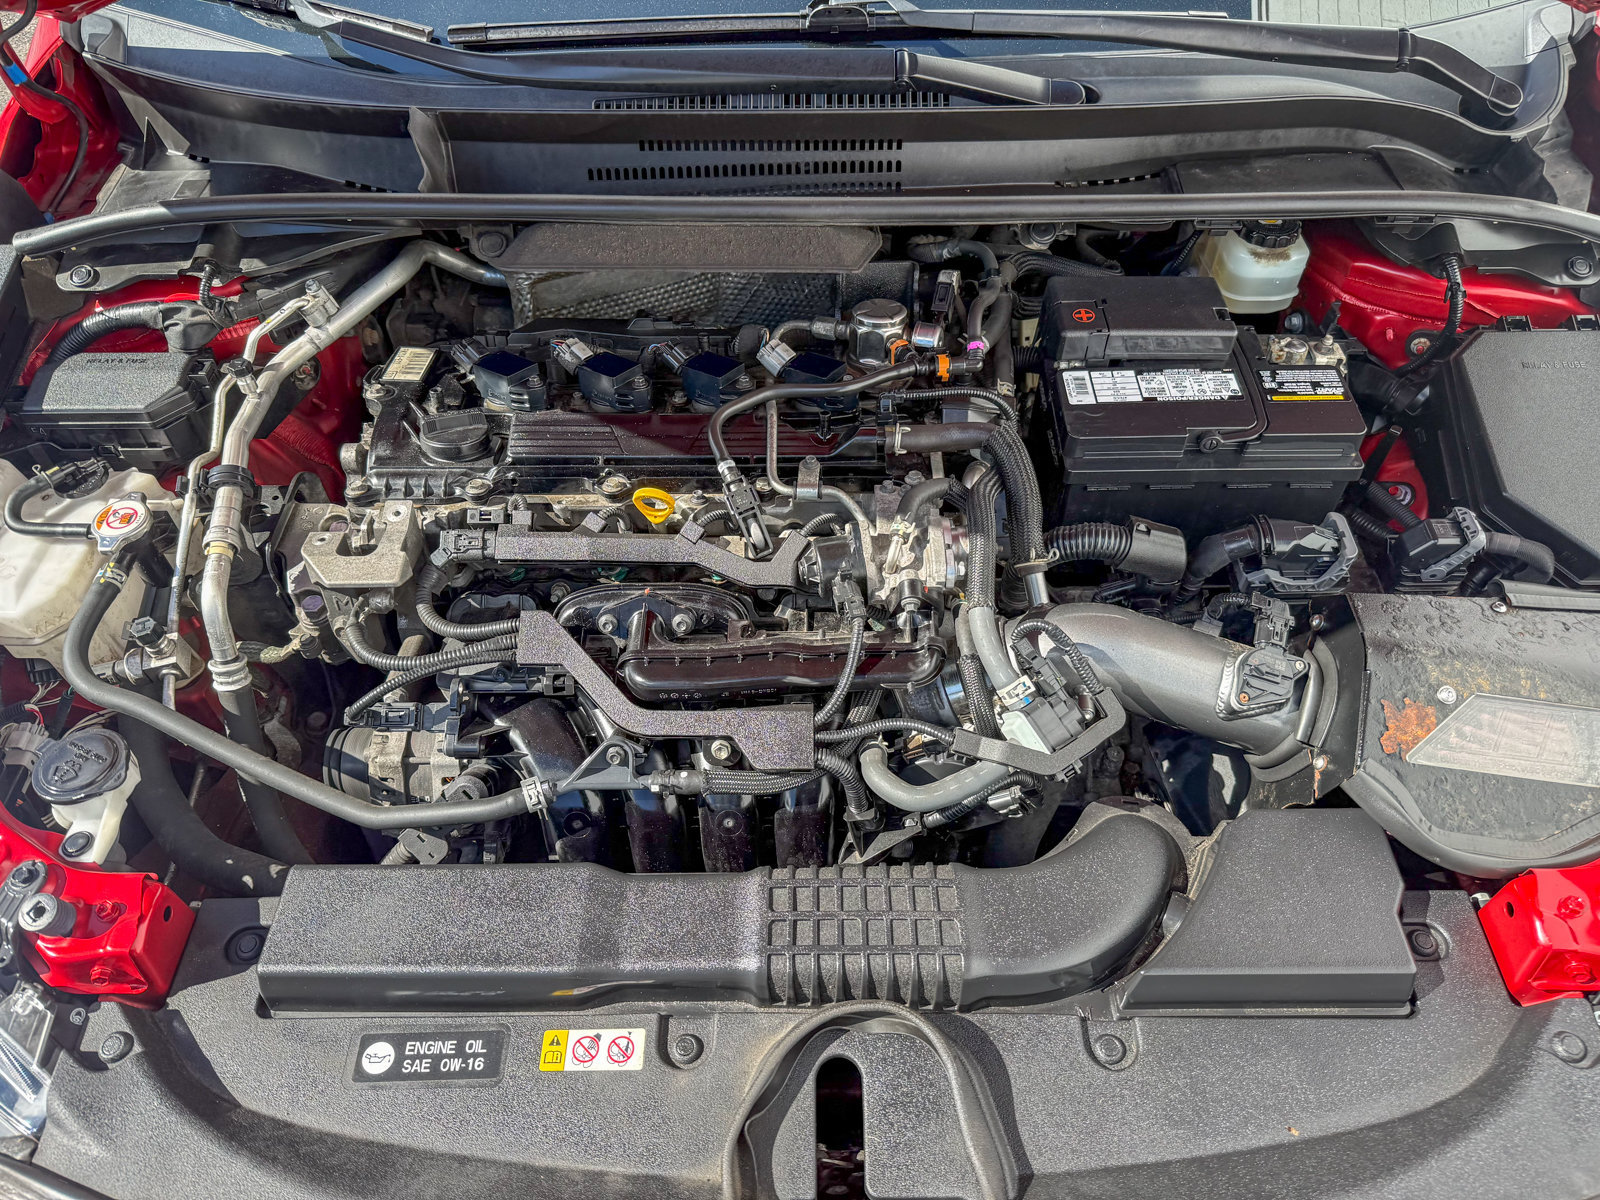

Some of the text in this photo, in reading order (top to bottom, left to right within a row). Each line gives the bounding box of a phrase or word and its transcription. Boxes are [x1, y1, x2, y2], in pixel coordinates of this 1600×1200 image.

[1562, 361, 1587, 369] FUSE
[405, 1040, 488, 1055] ENGINE OIL
[402, 1057, 485, 1073] SAE 0W-16
